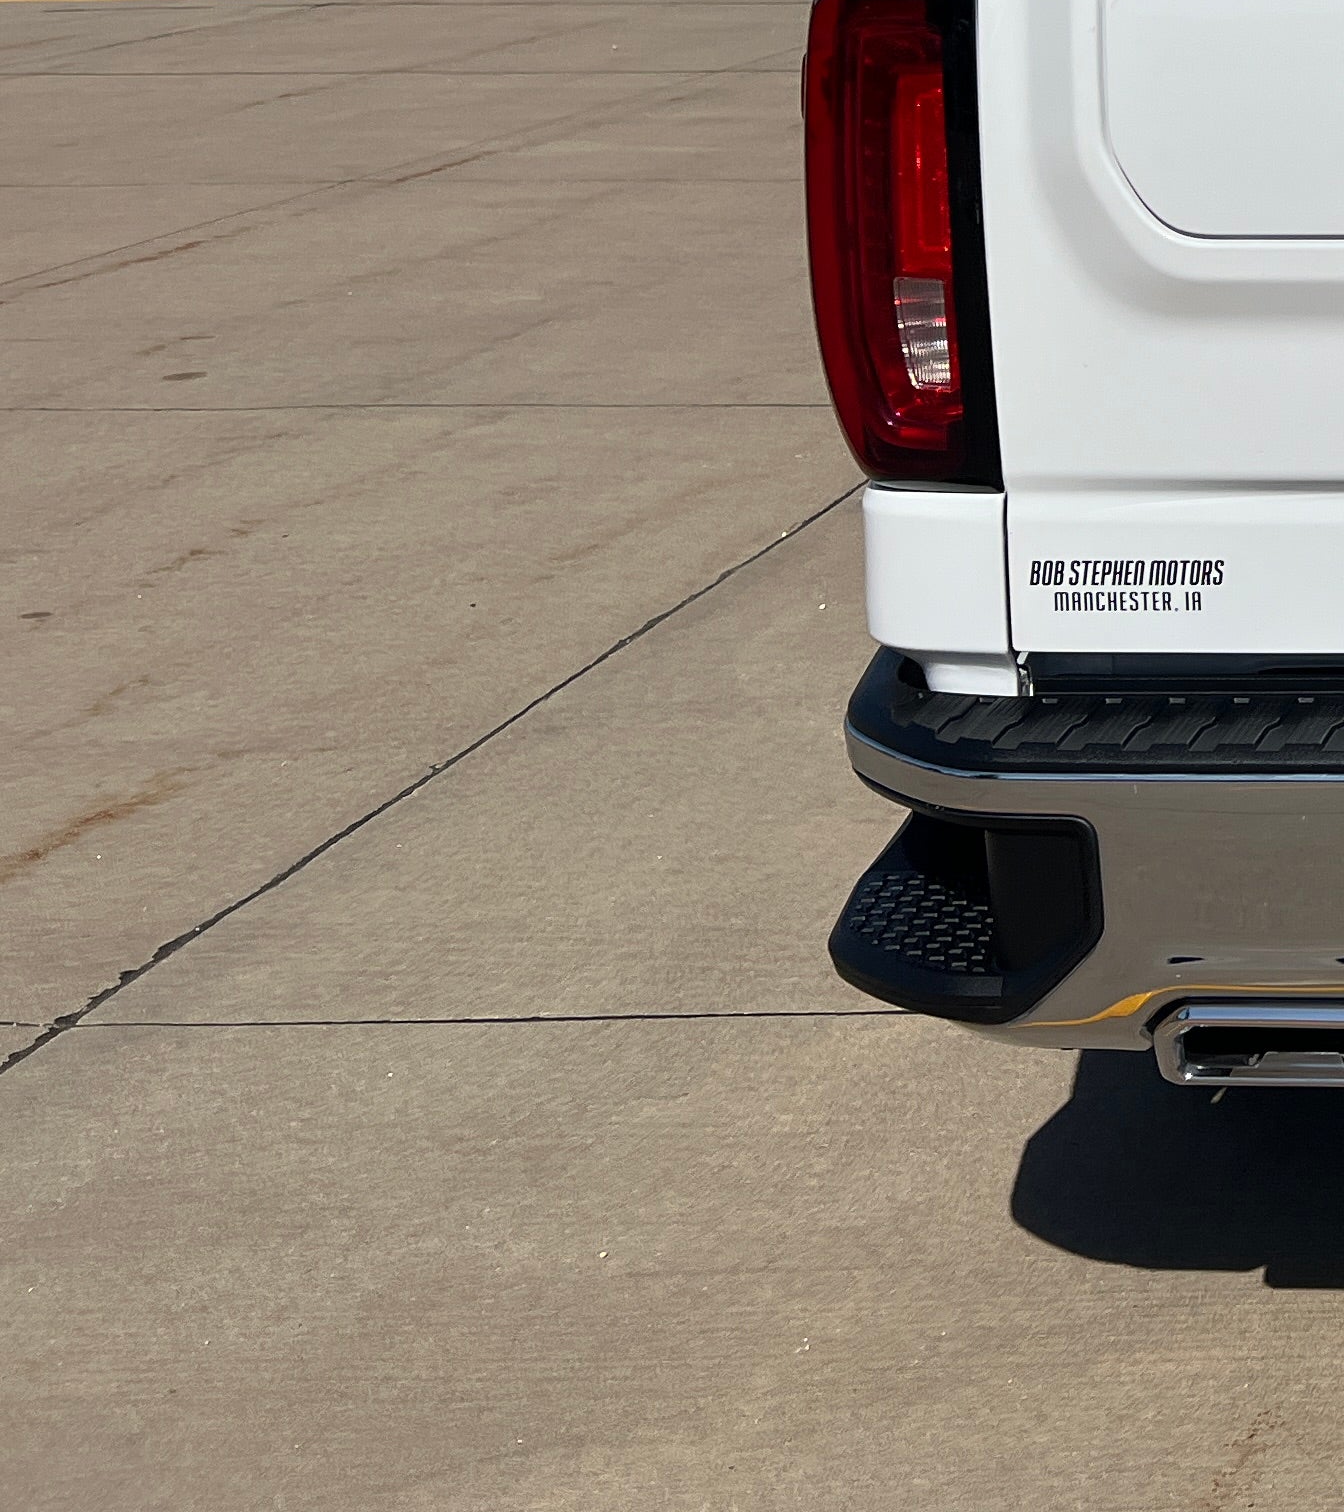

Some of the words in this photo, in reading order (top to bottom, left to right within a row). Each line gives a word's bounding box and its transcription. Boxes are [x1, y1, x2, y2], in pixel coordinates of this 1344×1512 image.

[1029, 560, 1065, 586] BOB
[1068, 560, 1145, 586] STEPHEN
[1149, 560, 1225, 586] MOTORS
[1185, 591, 1202, 611] IA
